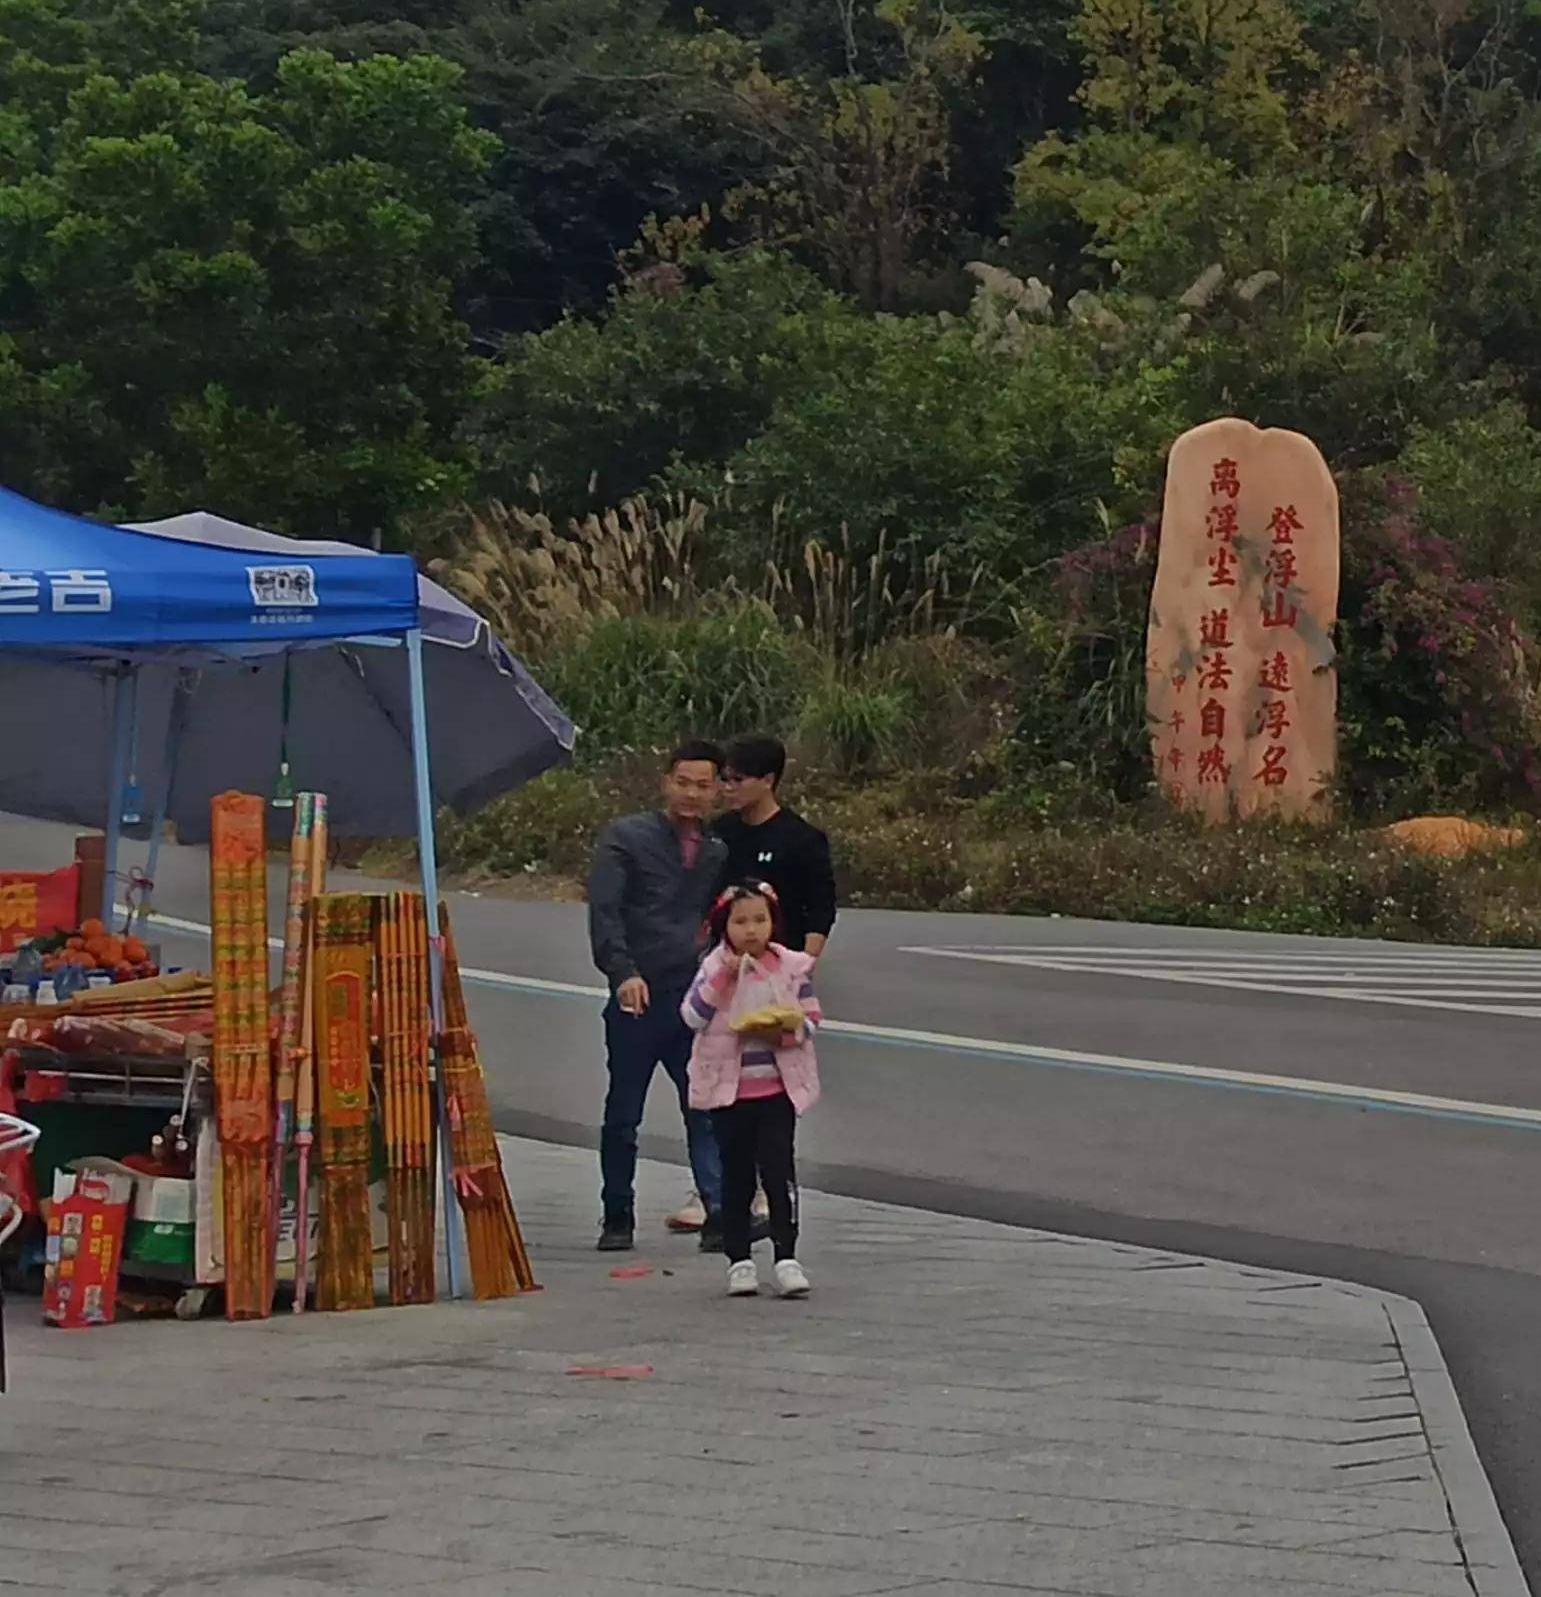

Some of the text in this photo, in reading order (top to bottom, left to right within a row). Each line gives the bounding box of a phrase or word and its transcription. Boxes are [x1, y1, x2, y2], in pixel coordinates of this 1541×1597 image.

[1196, 457, 1240, 785] 离浮尘 道法自然
[1263, 504, 1304, 629] 登浮山
